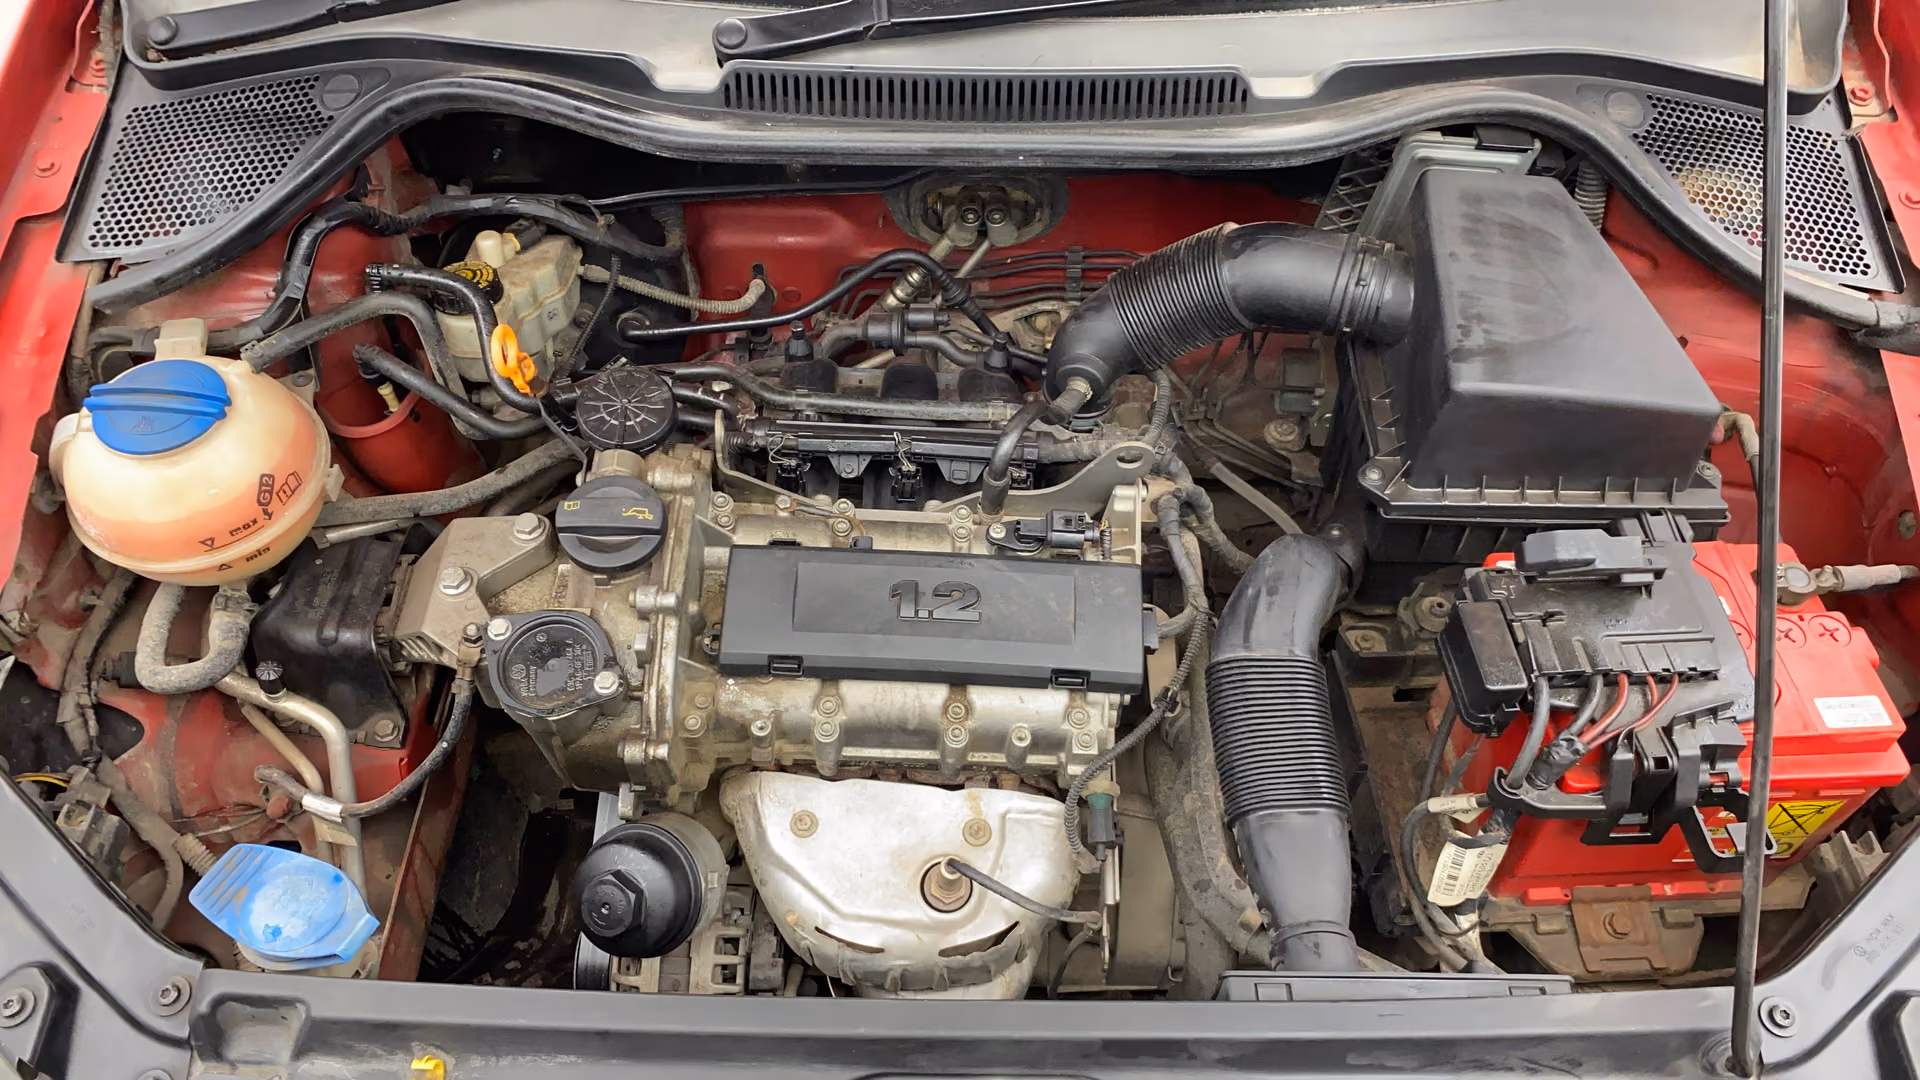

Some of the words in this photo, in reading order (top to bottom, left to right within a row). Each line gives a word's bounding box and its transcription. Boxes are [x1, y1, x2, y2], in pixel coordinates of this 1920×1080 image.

[261, 476, 273, 503] G12
[229, 518, 258, 537] max
[246, 547, 271, 562] min
[889, 579, 982, 623] 1.2
